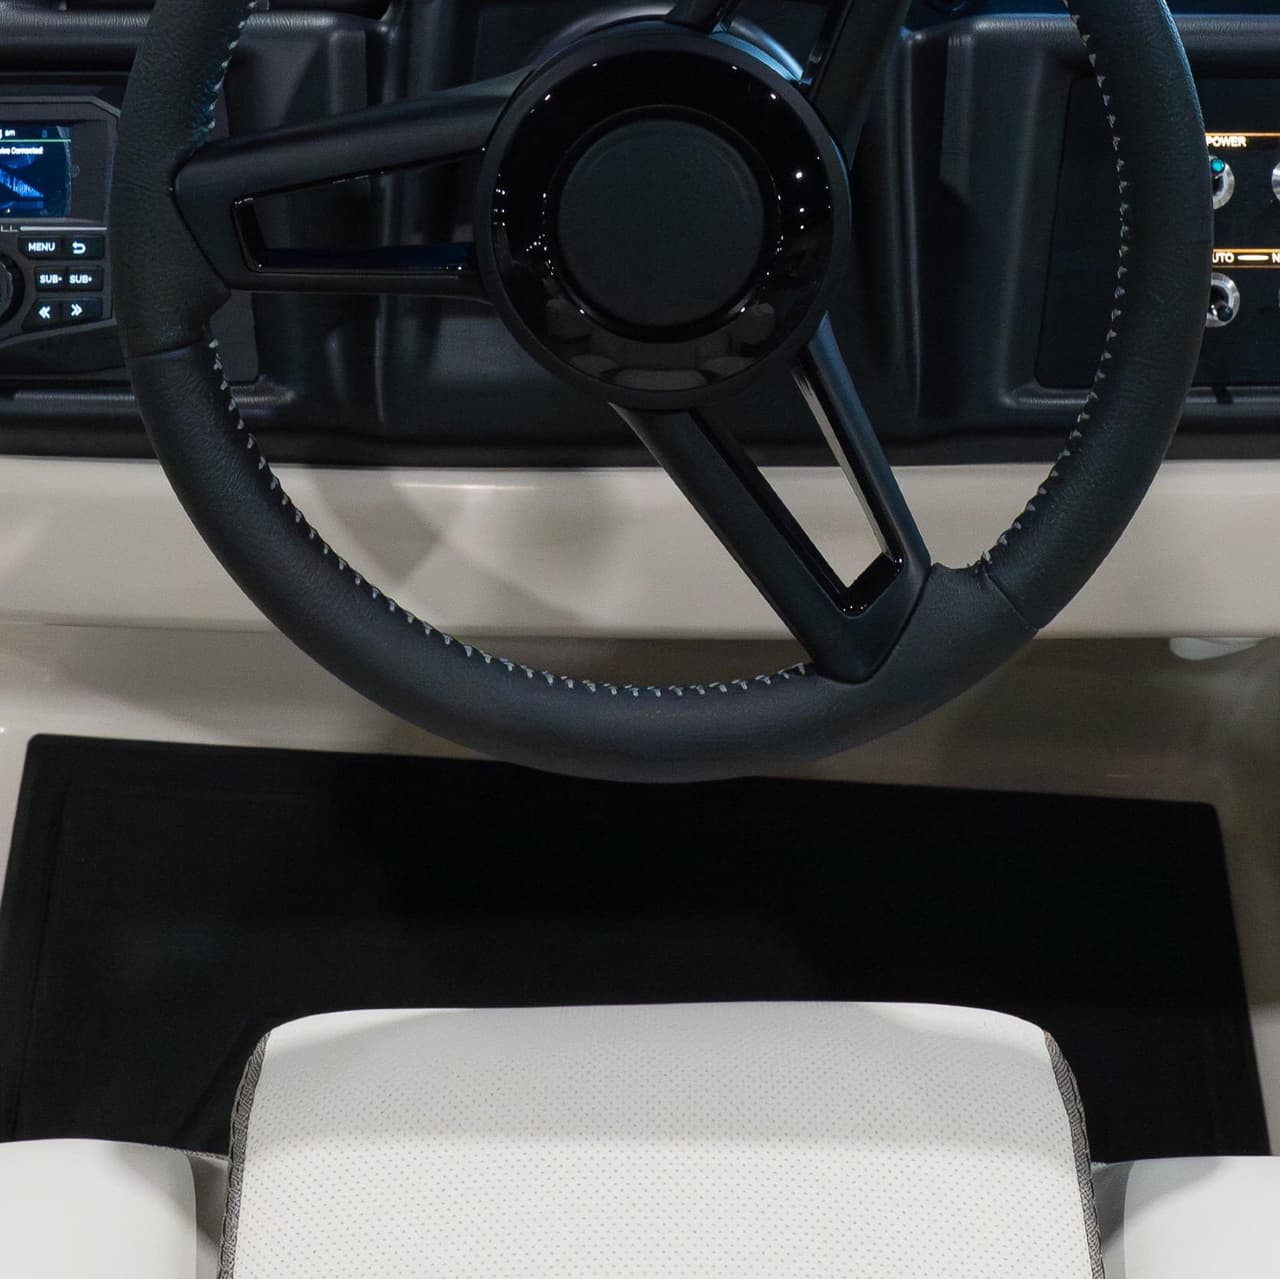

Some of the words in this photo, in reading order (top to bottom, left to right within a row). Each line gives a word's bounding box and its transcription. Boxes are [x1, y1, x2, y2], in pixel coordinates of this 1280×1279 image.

[1206, 136, 1247, 148] POWER
[28, 241, 56, 252] MENU
[1212, 253, 1234, 263] UTO
